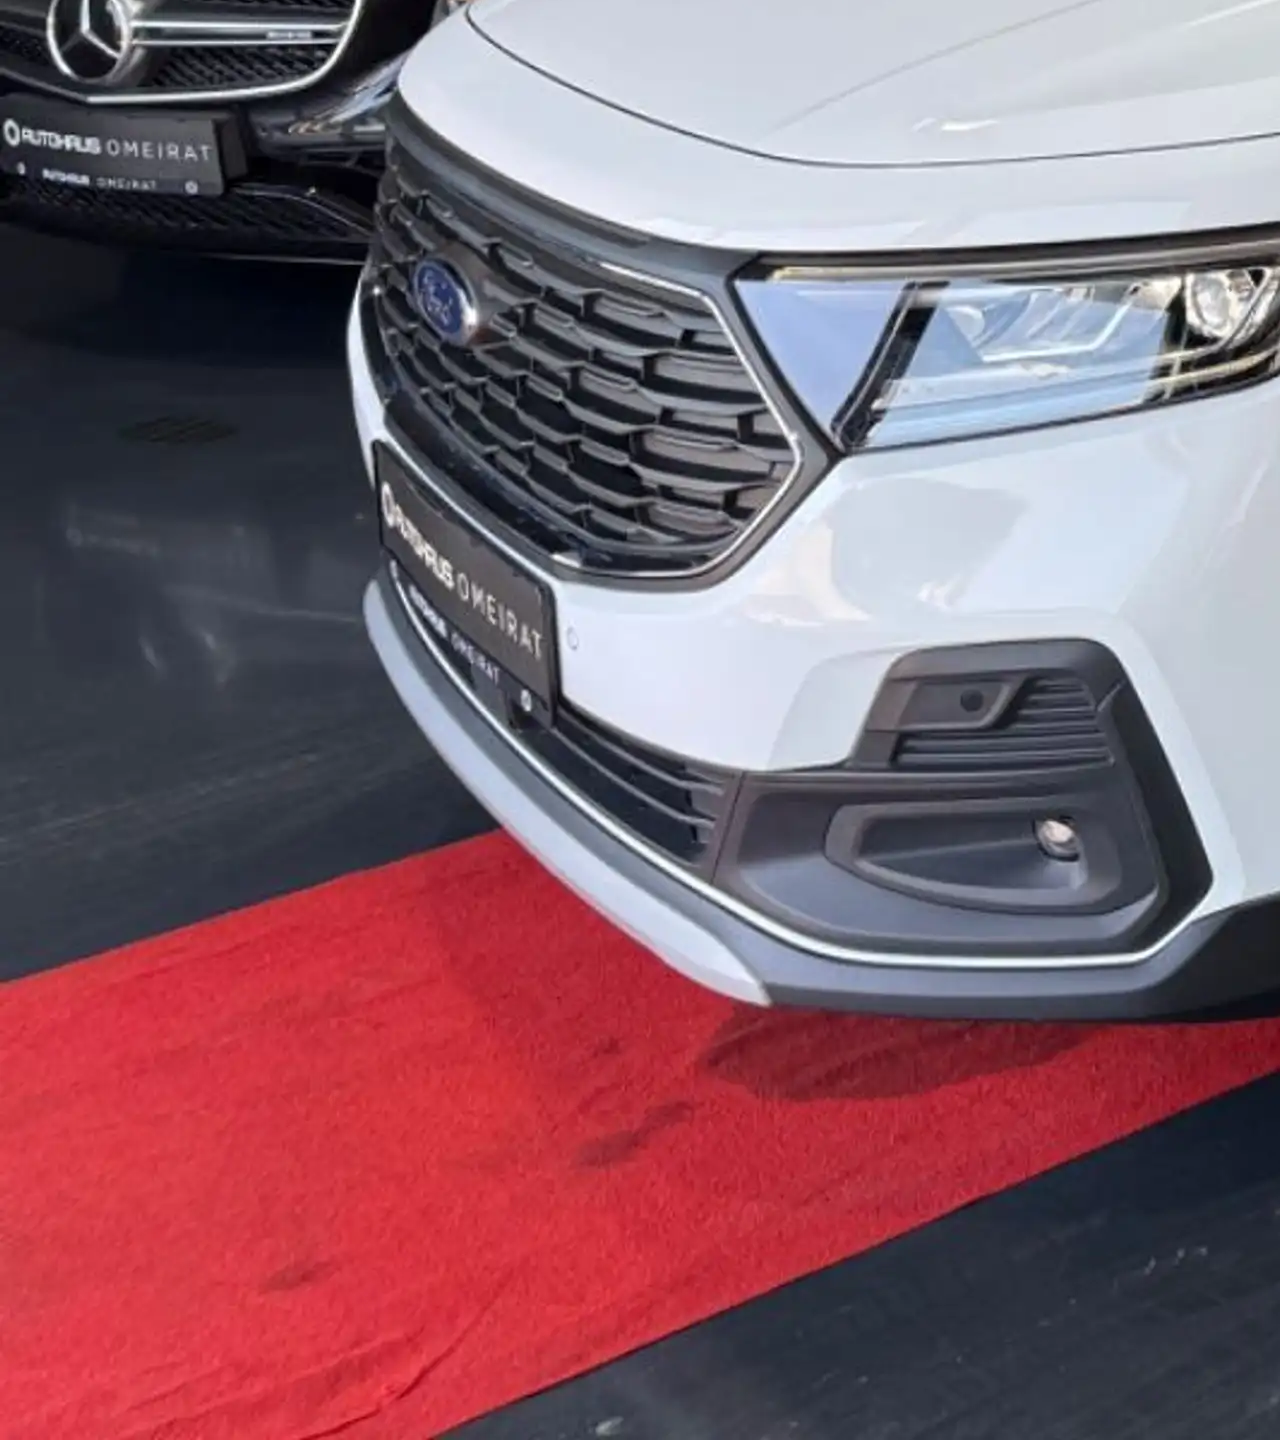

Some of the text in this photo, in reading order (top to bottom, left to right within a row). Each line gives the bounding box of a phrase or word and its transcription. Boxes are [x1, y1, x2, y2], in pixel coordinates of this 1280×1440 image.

[21, 126, 213, 161] AUTOHAUS OMEIRAT
[456, 572, 543, 659] OMEIRAT
